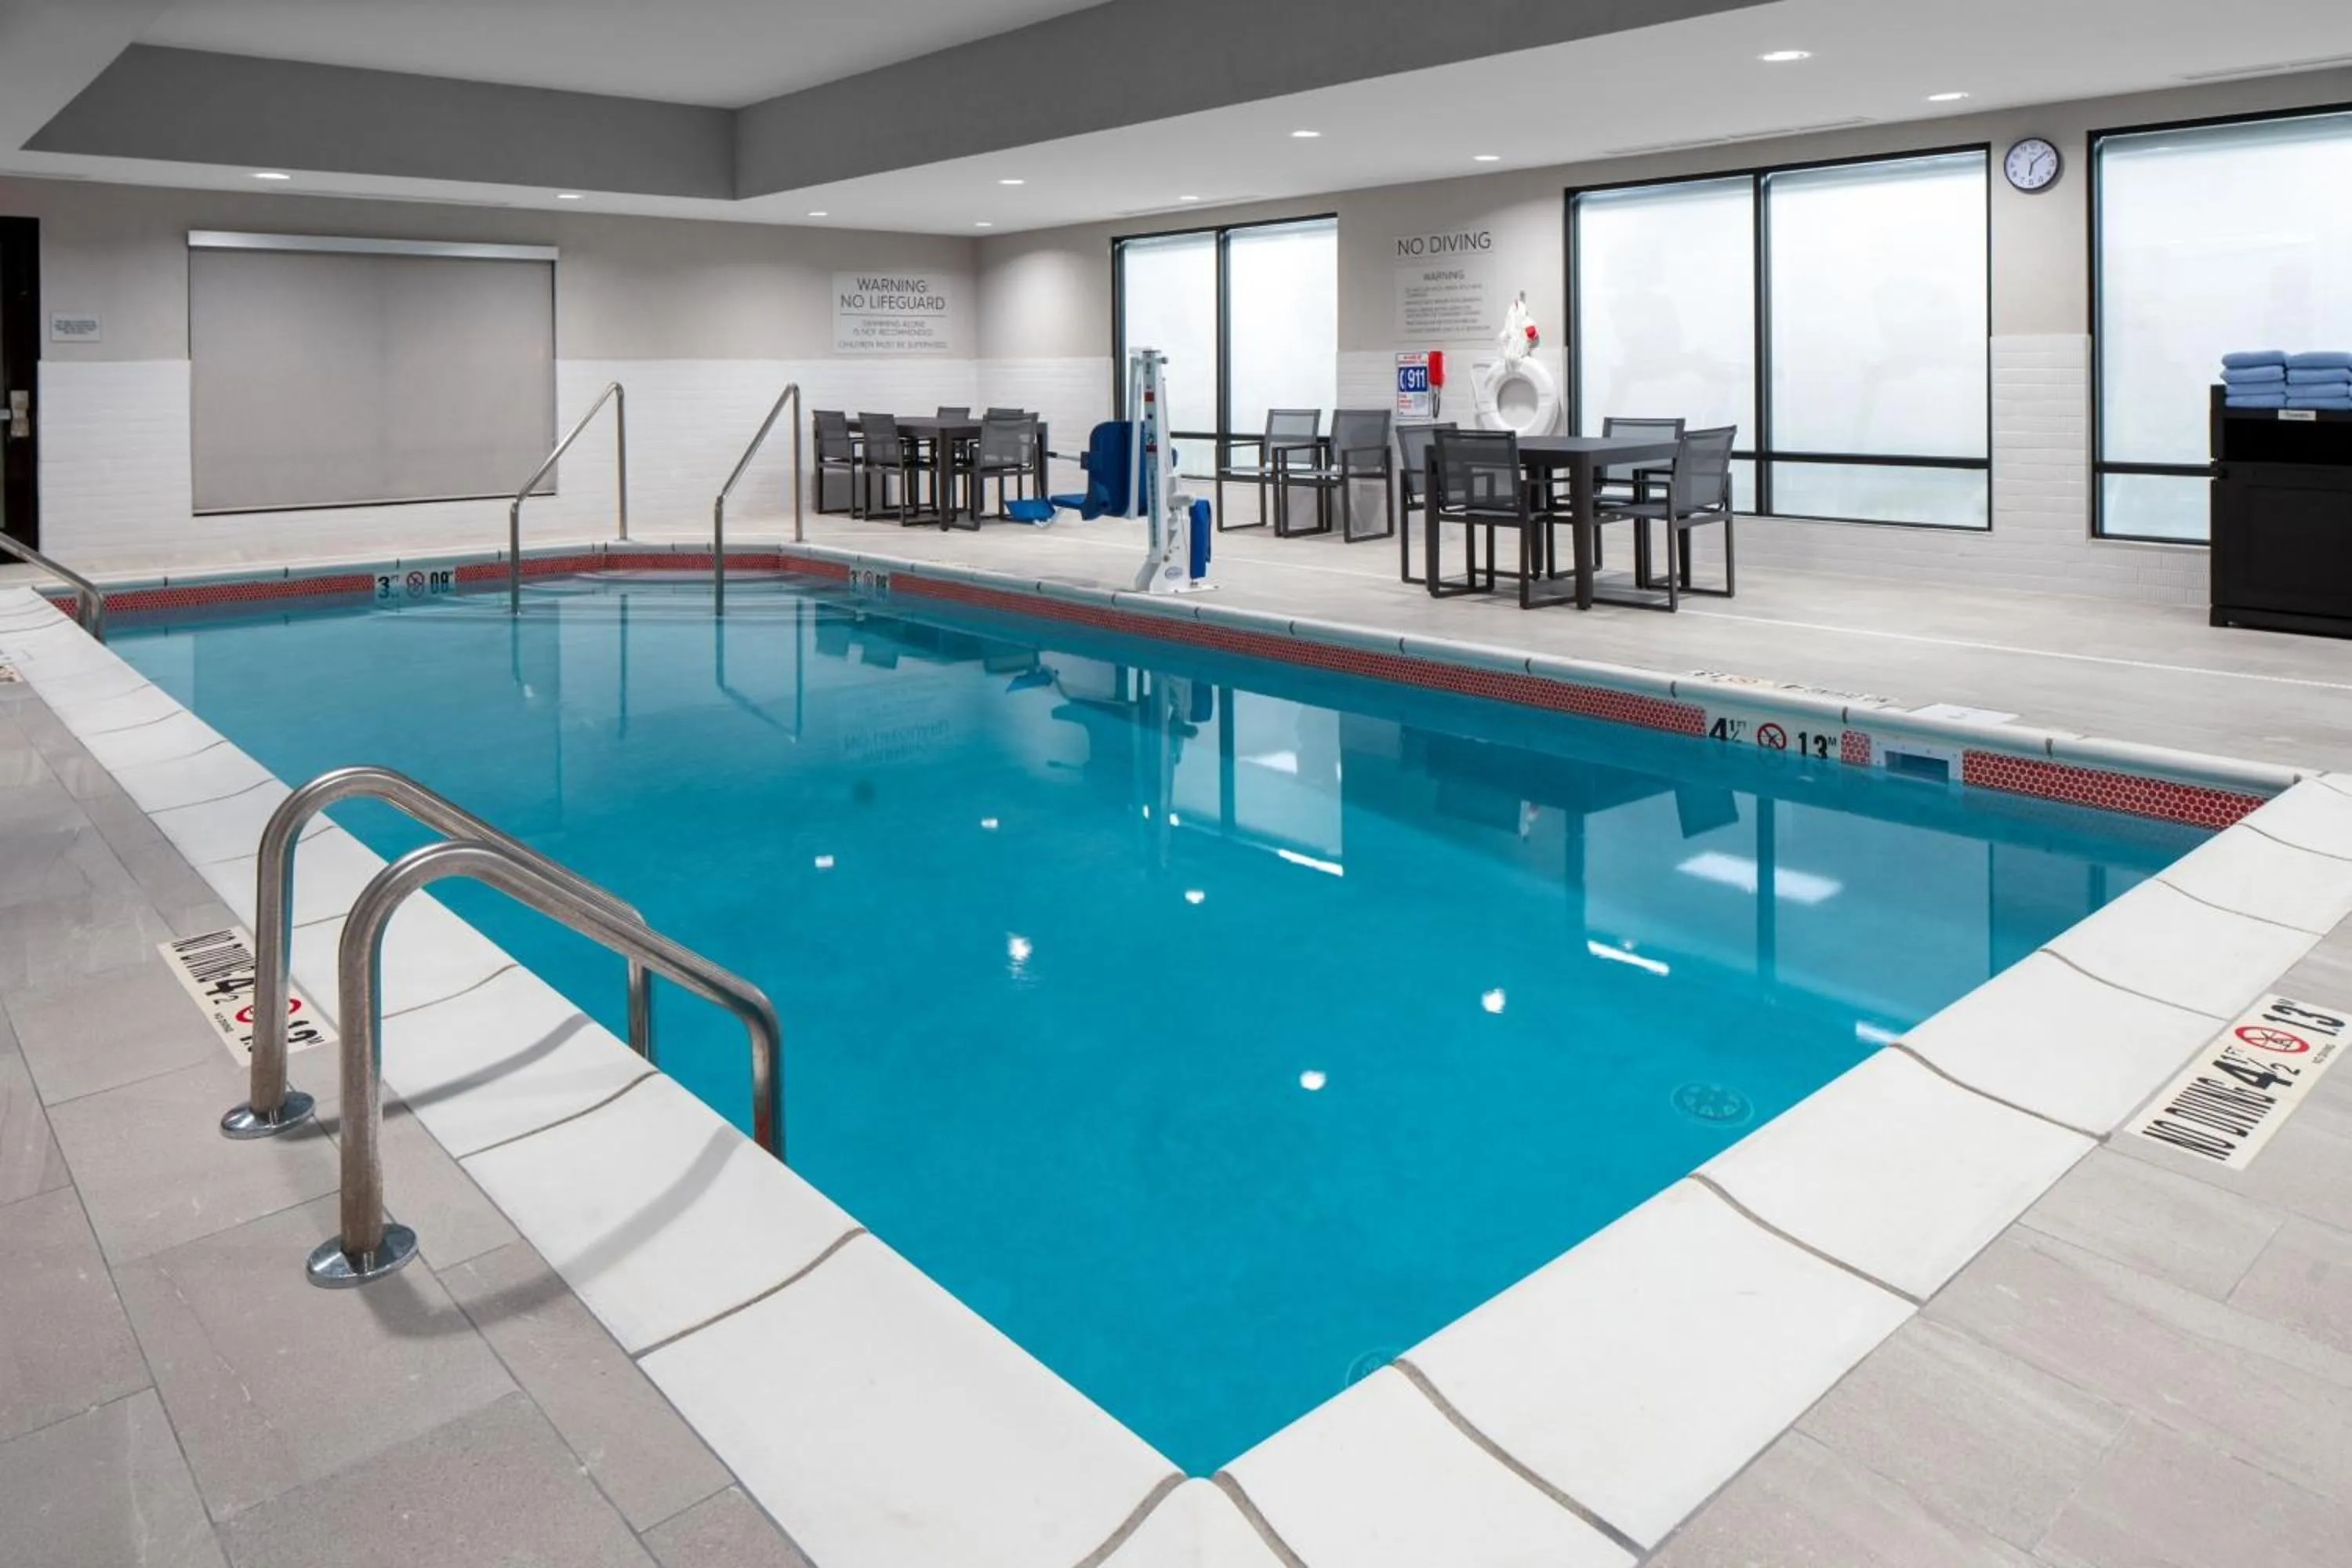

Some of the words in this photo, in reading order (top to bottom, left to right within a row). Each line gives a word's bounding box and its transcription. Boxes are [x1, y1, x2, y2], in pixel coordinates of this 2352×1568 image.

[1397, 238, 1425, 256] NO
[1430, 231, 1492, 254] DIVING
[840, 294, 865, 309] NO
[869, 295, 946, 310] LIFEGUARD
[1407, 368, 1426, 389] 911
[2164, 1077, 2277, 1138] DIVING
[2142, 1120, 2236, 1160] NO
